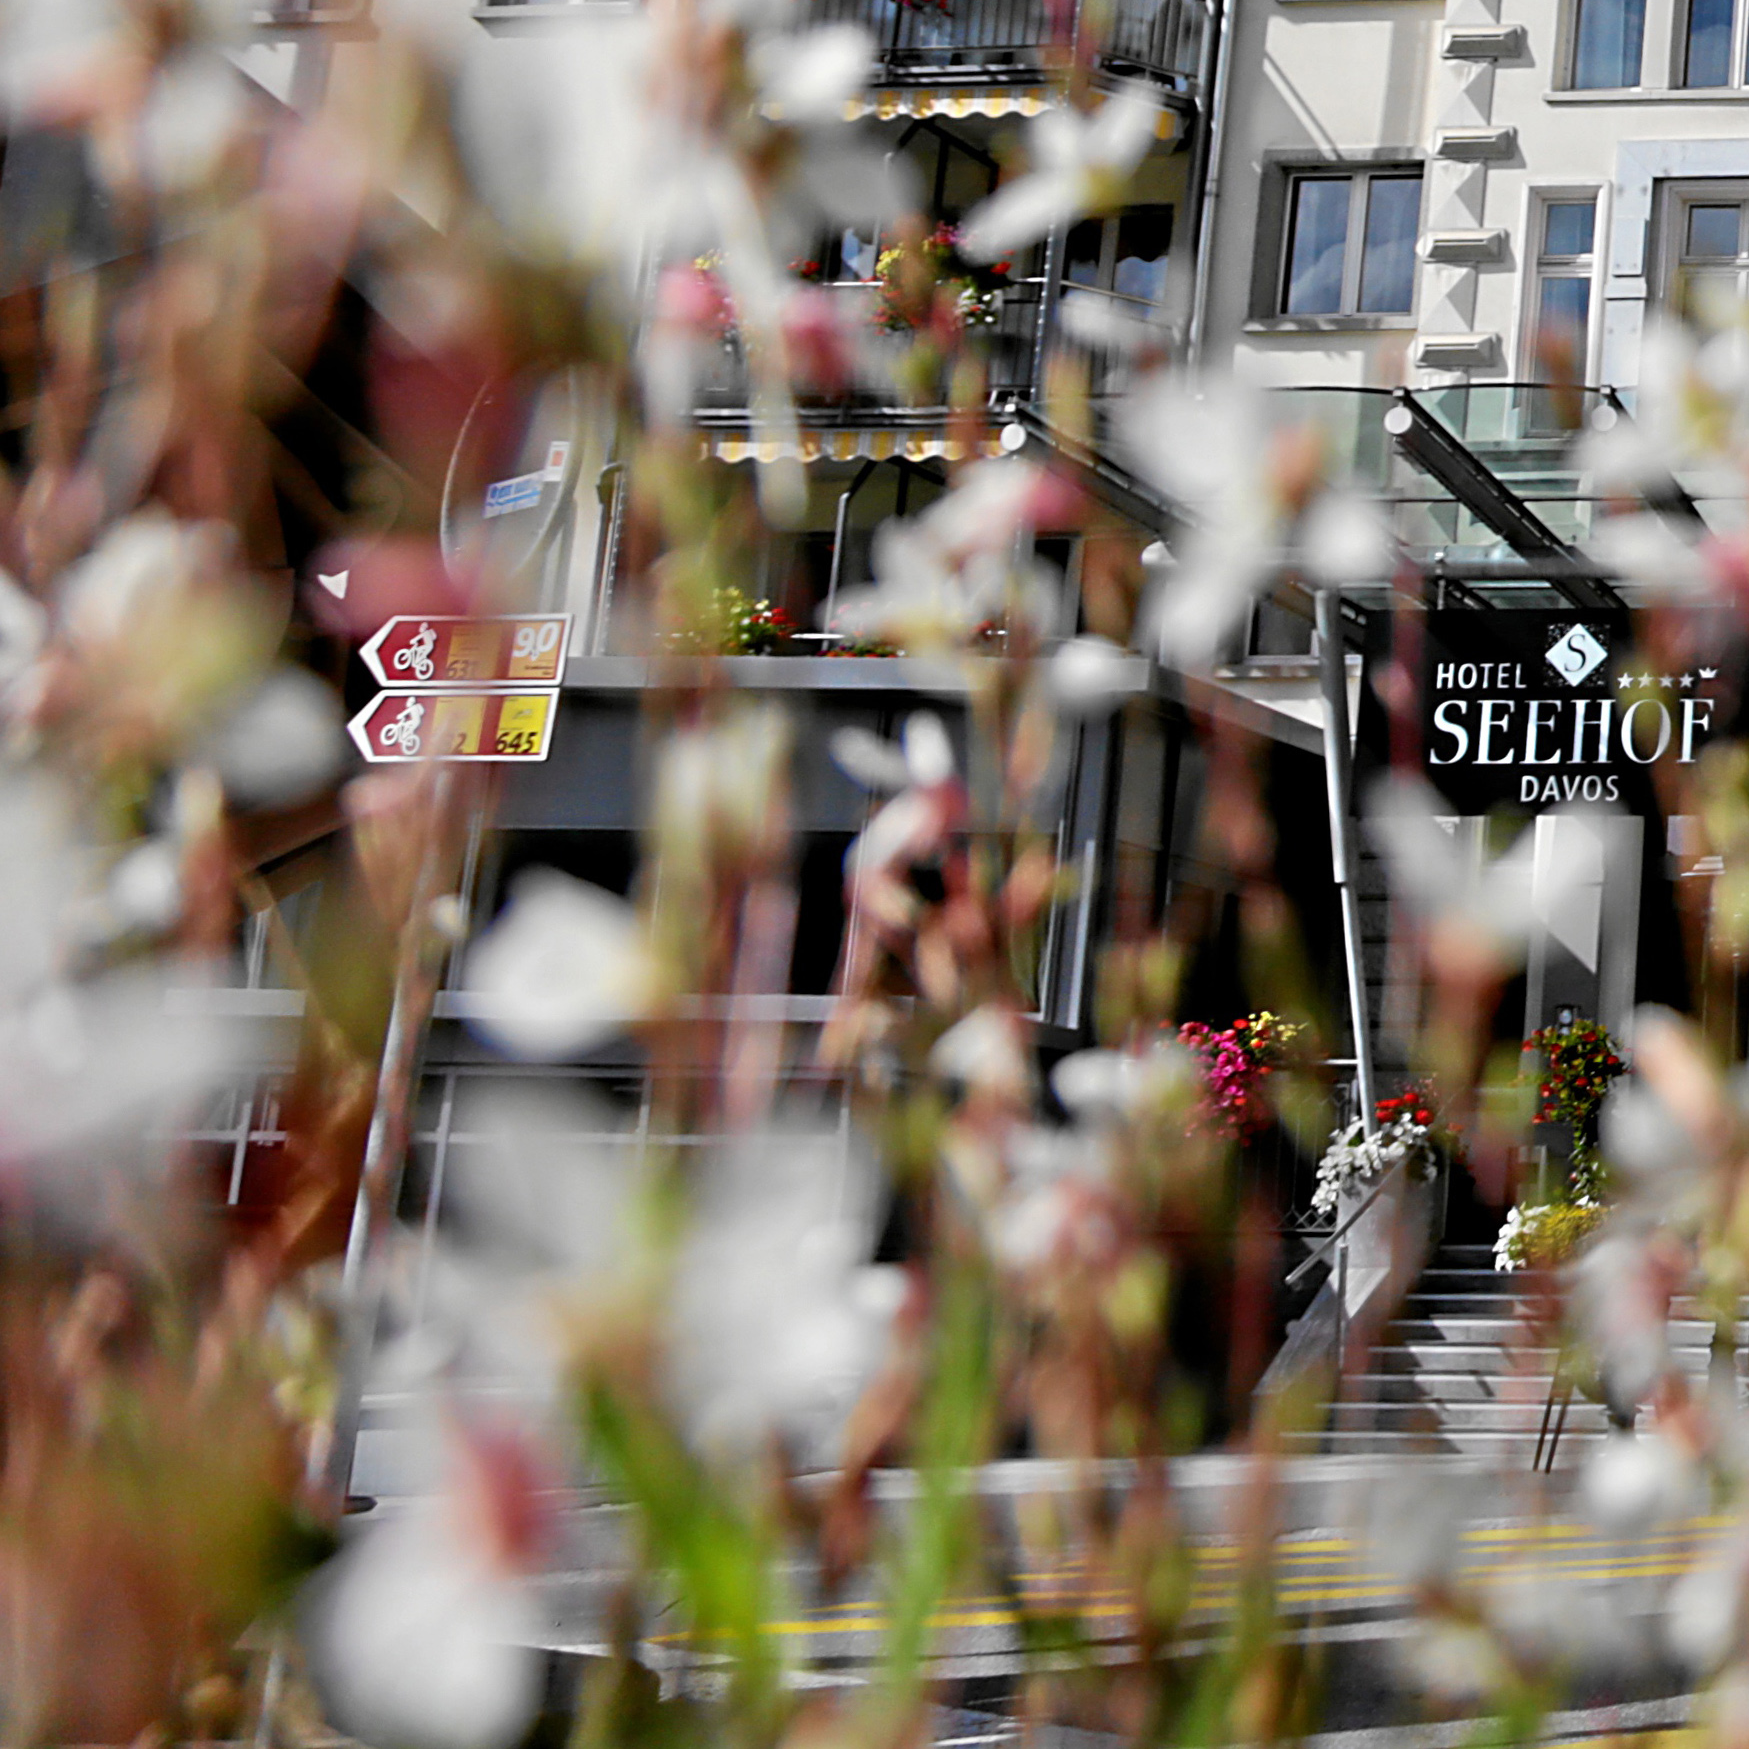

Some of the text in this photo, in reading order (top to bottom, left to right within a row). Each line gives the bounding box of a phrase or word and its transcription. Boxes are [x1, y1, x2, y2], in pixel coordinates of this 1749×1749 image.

[1564, 633, 1586, 672] S
[1436, 663, 1527, 689] HOTEL
[496, 732, 538, 753] 645
[1429, 698, 1715, 764] SEEHOF
[1520, 775, 1619, 802] DAVOS
